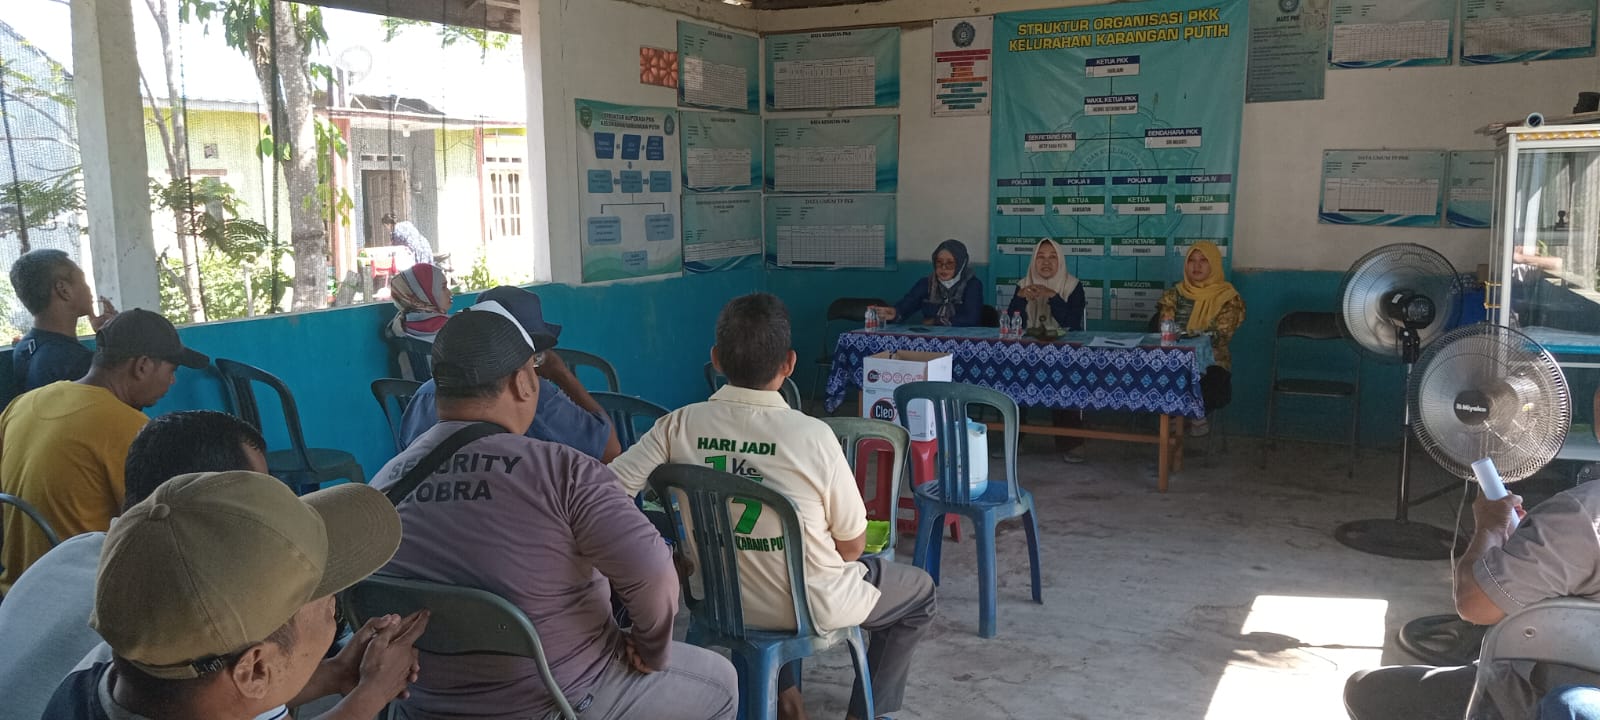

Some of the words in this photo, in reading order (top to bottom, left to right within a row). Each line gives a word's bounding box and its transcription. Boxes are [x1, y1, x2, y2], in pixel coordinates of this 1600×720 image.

[1017, 18, 1090, 36] STRUKTUR
[1093, 11, 1183, 31] ORGANISASI
[1187, 8, 1220, 23] PKK
[1008, 33, 1092, 52] KELURAHAN
[1095, 27, 1179, 47] KARANGAN
[1183, 23, 1230, 40] PUTIH
[1148, 129, 1184, 137] BENDAHARA
[1190, 175, 1209, 183] POKJA
[875, 404, 894, 418] Cleo
[697, 437, 736, 452] HARI
[739, 441, 776, 456] JADI
[388, 453, 522, 481] SEURITY
[406, 480, 492, 504] OBRA
